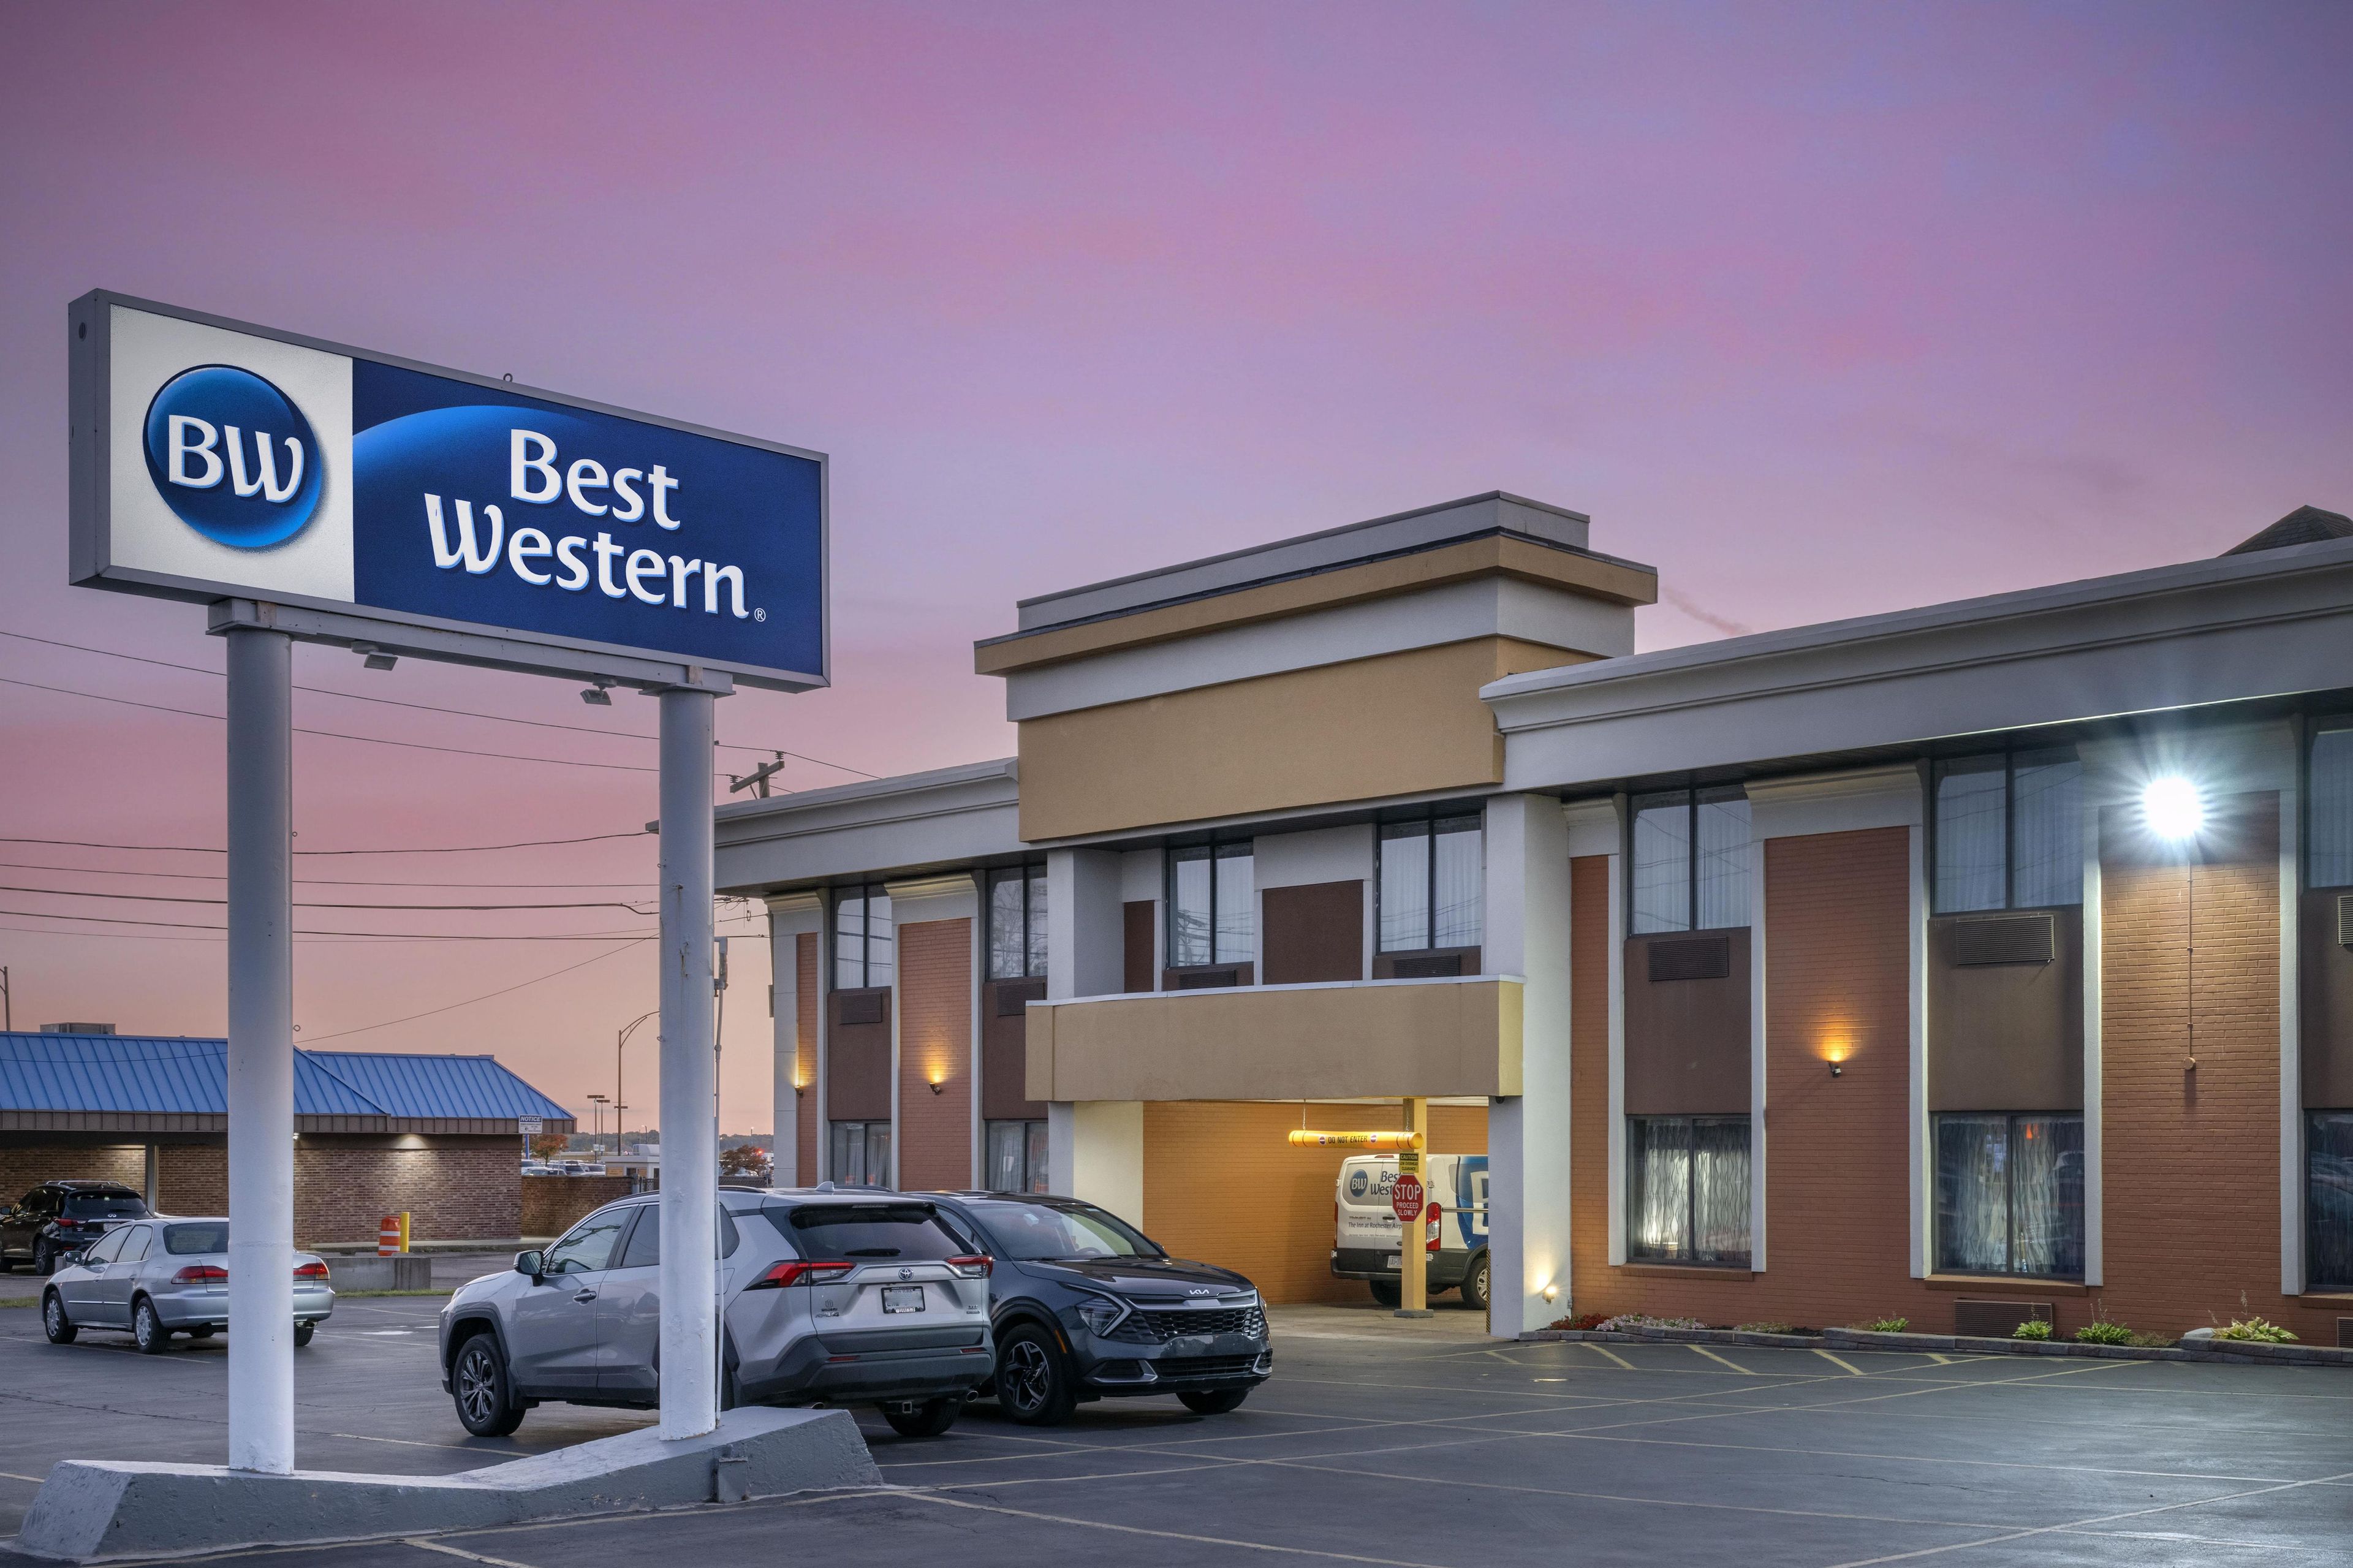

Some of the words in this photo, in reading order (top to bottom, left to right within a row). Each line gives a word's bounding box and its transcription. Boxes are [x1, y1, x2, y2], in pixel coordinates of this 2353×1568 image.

[169, 414, 305, 503] BW
[511, 428, 681, 531] Best
[1352, 1178, 1366, 1190] BW
[1381, 1171, 1401, 1183] Bes
[1395, 1184, 1421, 1200] STOP
